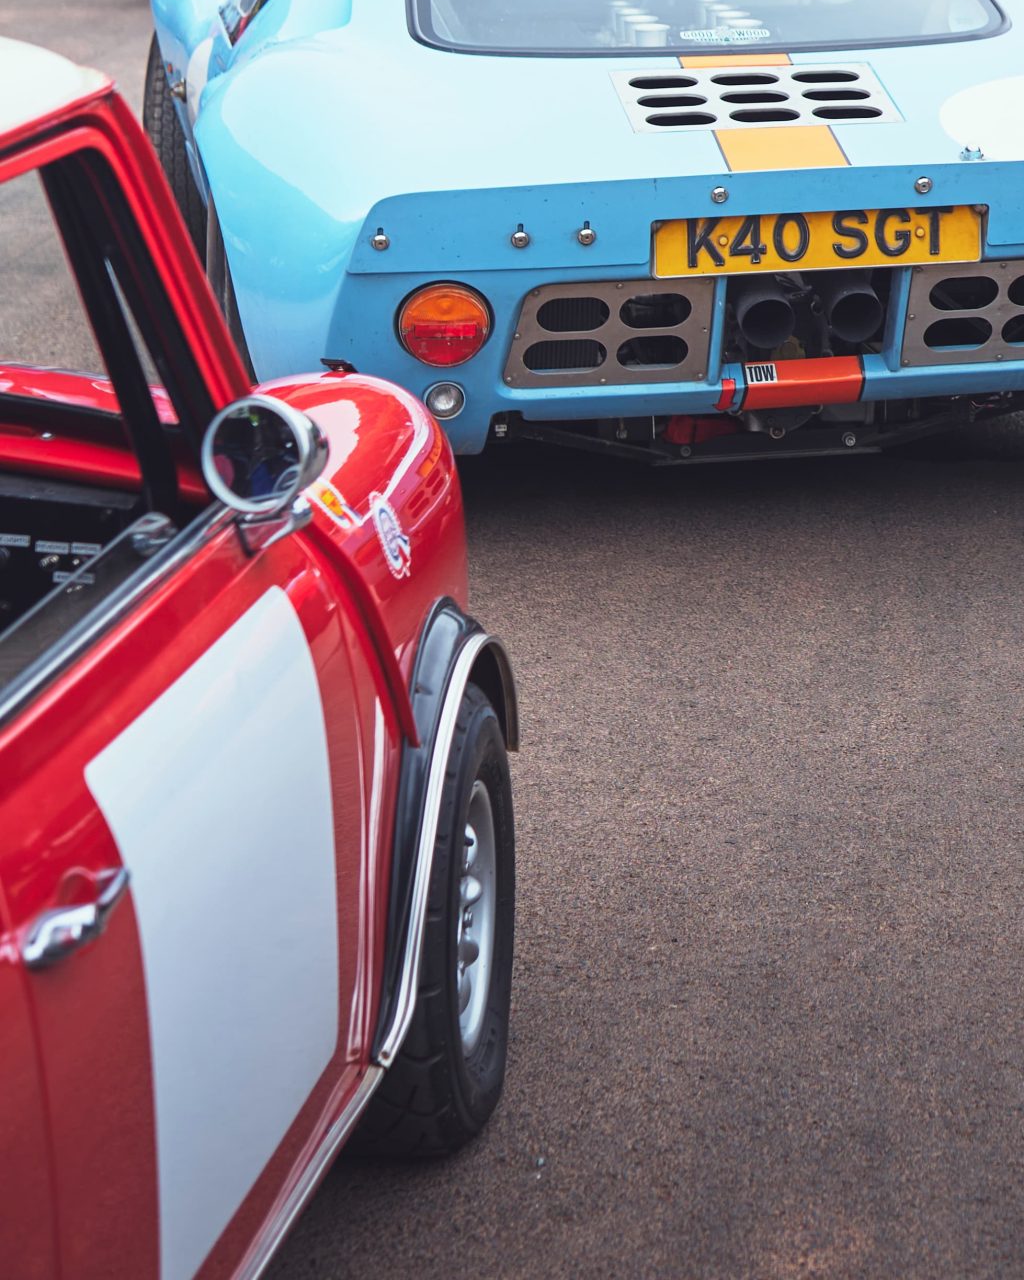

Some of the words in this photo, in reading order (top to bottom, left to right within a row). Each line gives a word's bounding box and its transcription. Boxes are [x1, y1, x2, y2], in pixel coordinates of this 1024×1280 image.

[686, 213, 810, 268] K40
[832, 207, 953, 259] SGT
[746, 364, 774, 382] TOW
